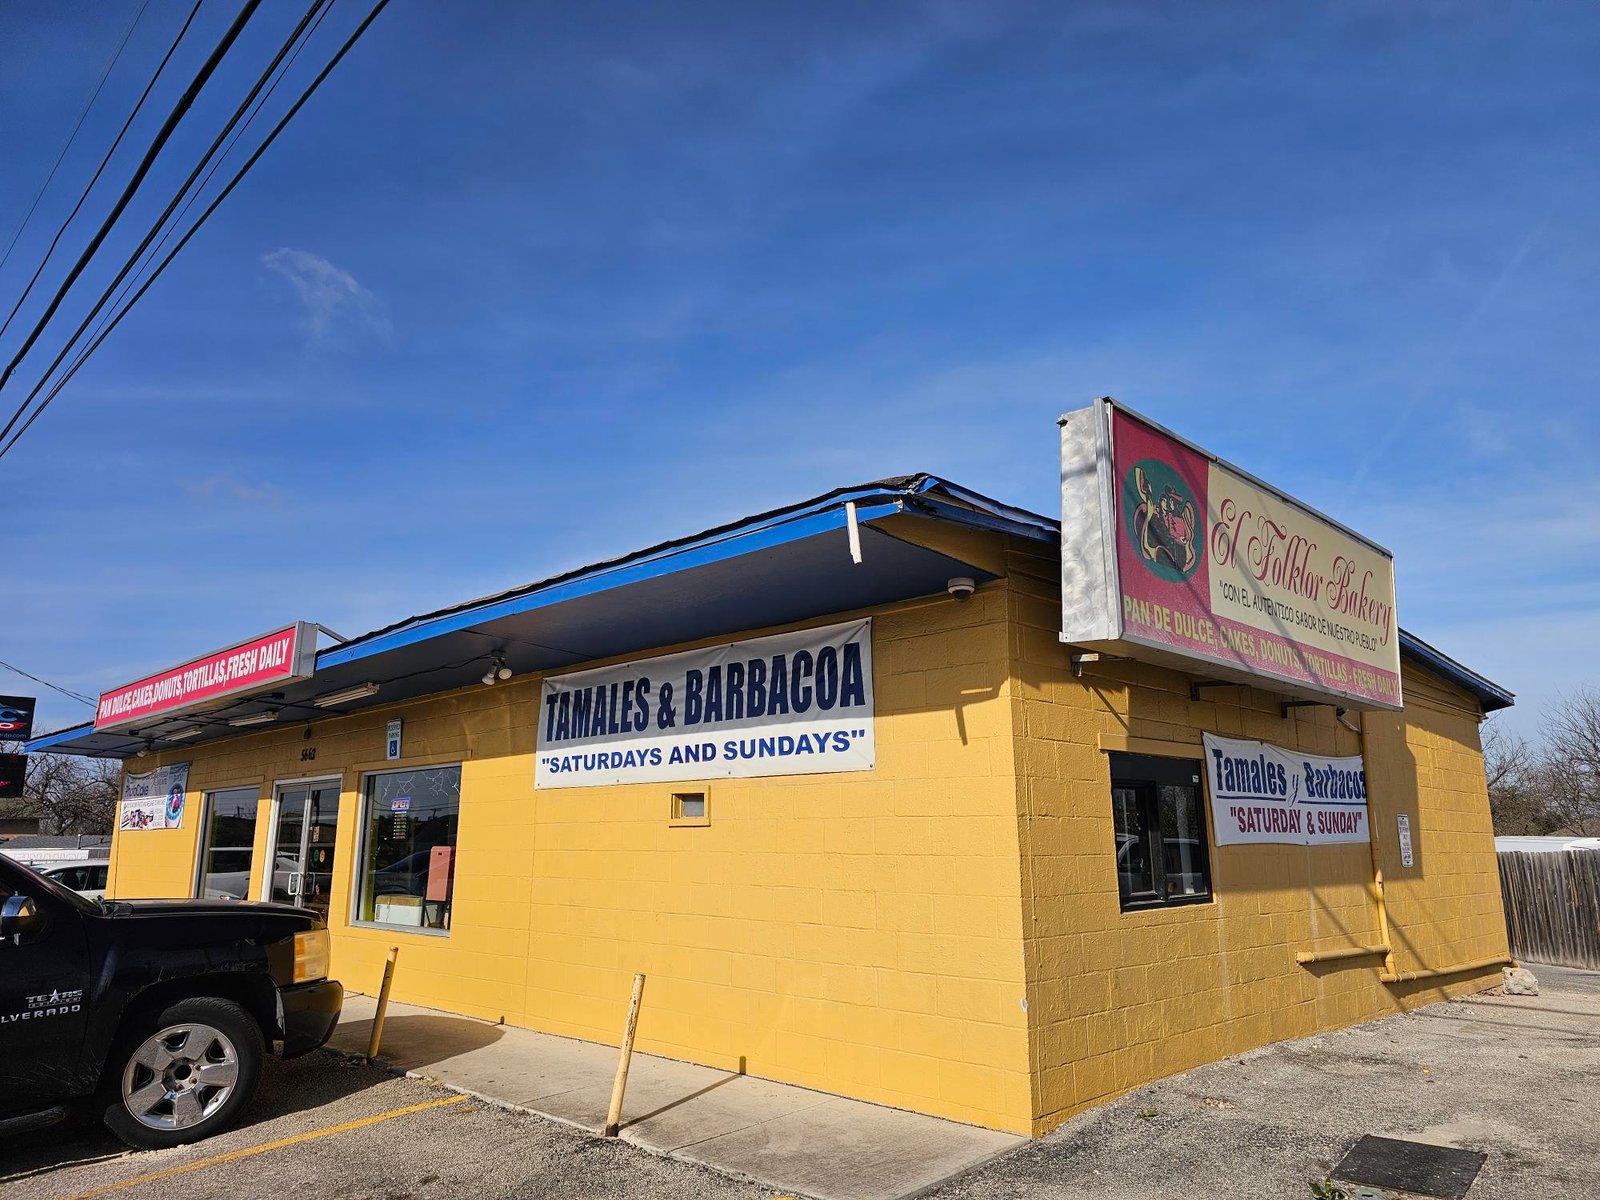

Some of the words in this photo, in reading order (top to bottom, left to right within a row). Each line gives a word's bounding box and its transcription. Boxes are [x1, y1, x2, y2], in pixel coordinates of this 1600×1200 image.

[1211, 498, 1252, 569] El
[1247, 516, 1324, 601] Folklor
[1326, 556, 1392, 647] Bakery
[1124, 595, 1151, 627] PAN
[1153, 604, 1172, 633] DE
[1174, 611, 1218, 651] DULCE,
[1220, 625, 1258, 662] CAKES,
[1303, 651, 1348, 684] TORTILLAS
[1353, 666, 1377, 691] FRESH
[1377, 674, 1398, 697] DAILY
[1242, 588, 1251, 608] EL
[1252, 594, 1294, 623] AUTENTICO
[1295, 610, 1317, 630] SABOR
[1318, 618, 1327, 636] DE
[1327, 621, 1354, 645] NUESTRO
[98, 698, 113, 720] PAN
[258, 637, 290, 671] DAILY
[546, 677, 651, 742] TAMALES
[657, 682, 676, 730] &
[684, 642, 866, 726] BARBACOA
[542, 748, 663, 774] "SATURDAYS
[669, 742, 717, 765] AND
[723, 729, 866, 761] SUNDAYS"
[1212, 749, 1287, 796] Tamales
[1288, 774, 1299, 808] y
[1230, 806, 1302, 834] "SATURDAY
[1306, 811, 1316, 836] &
[1317, 810, 1362, 835] SUNDAY"
